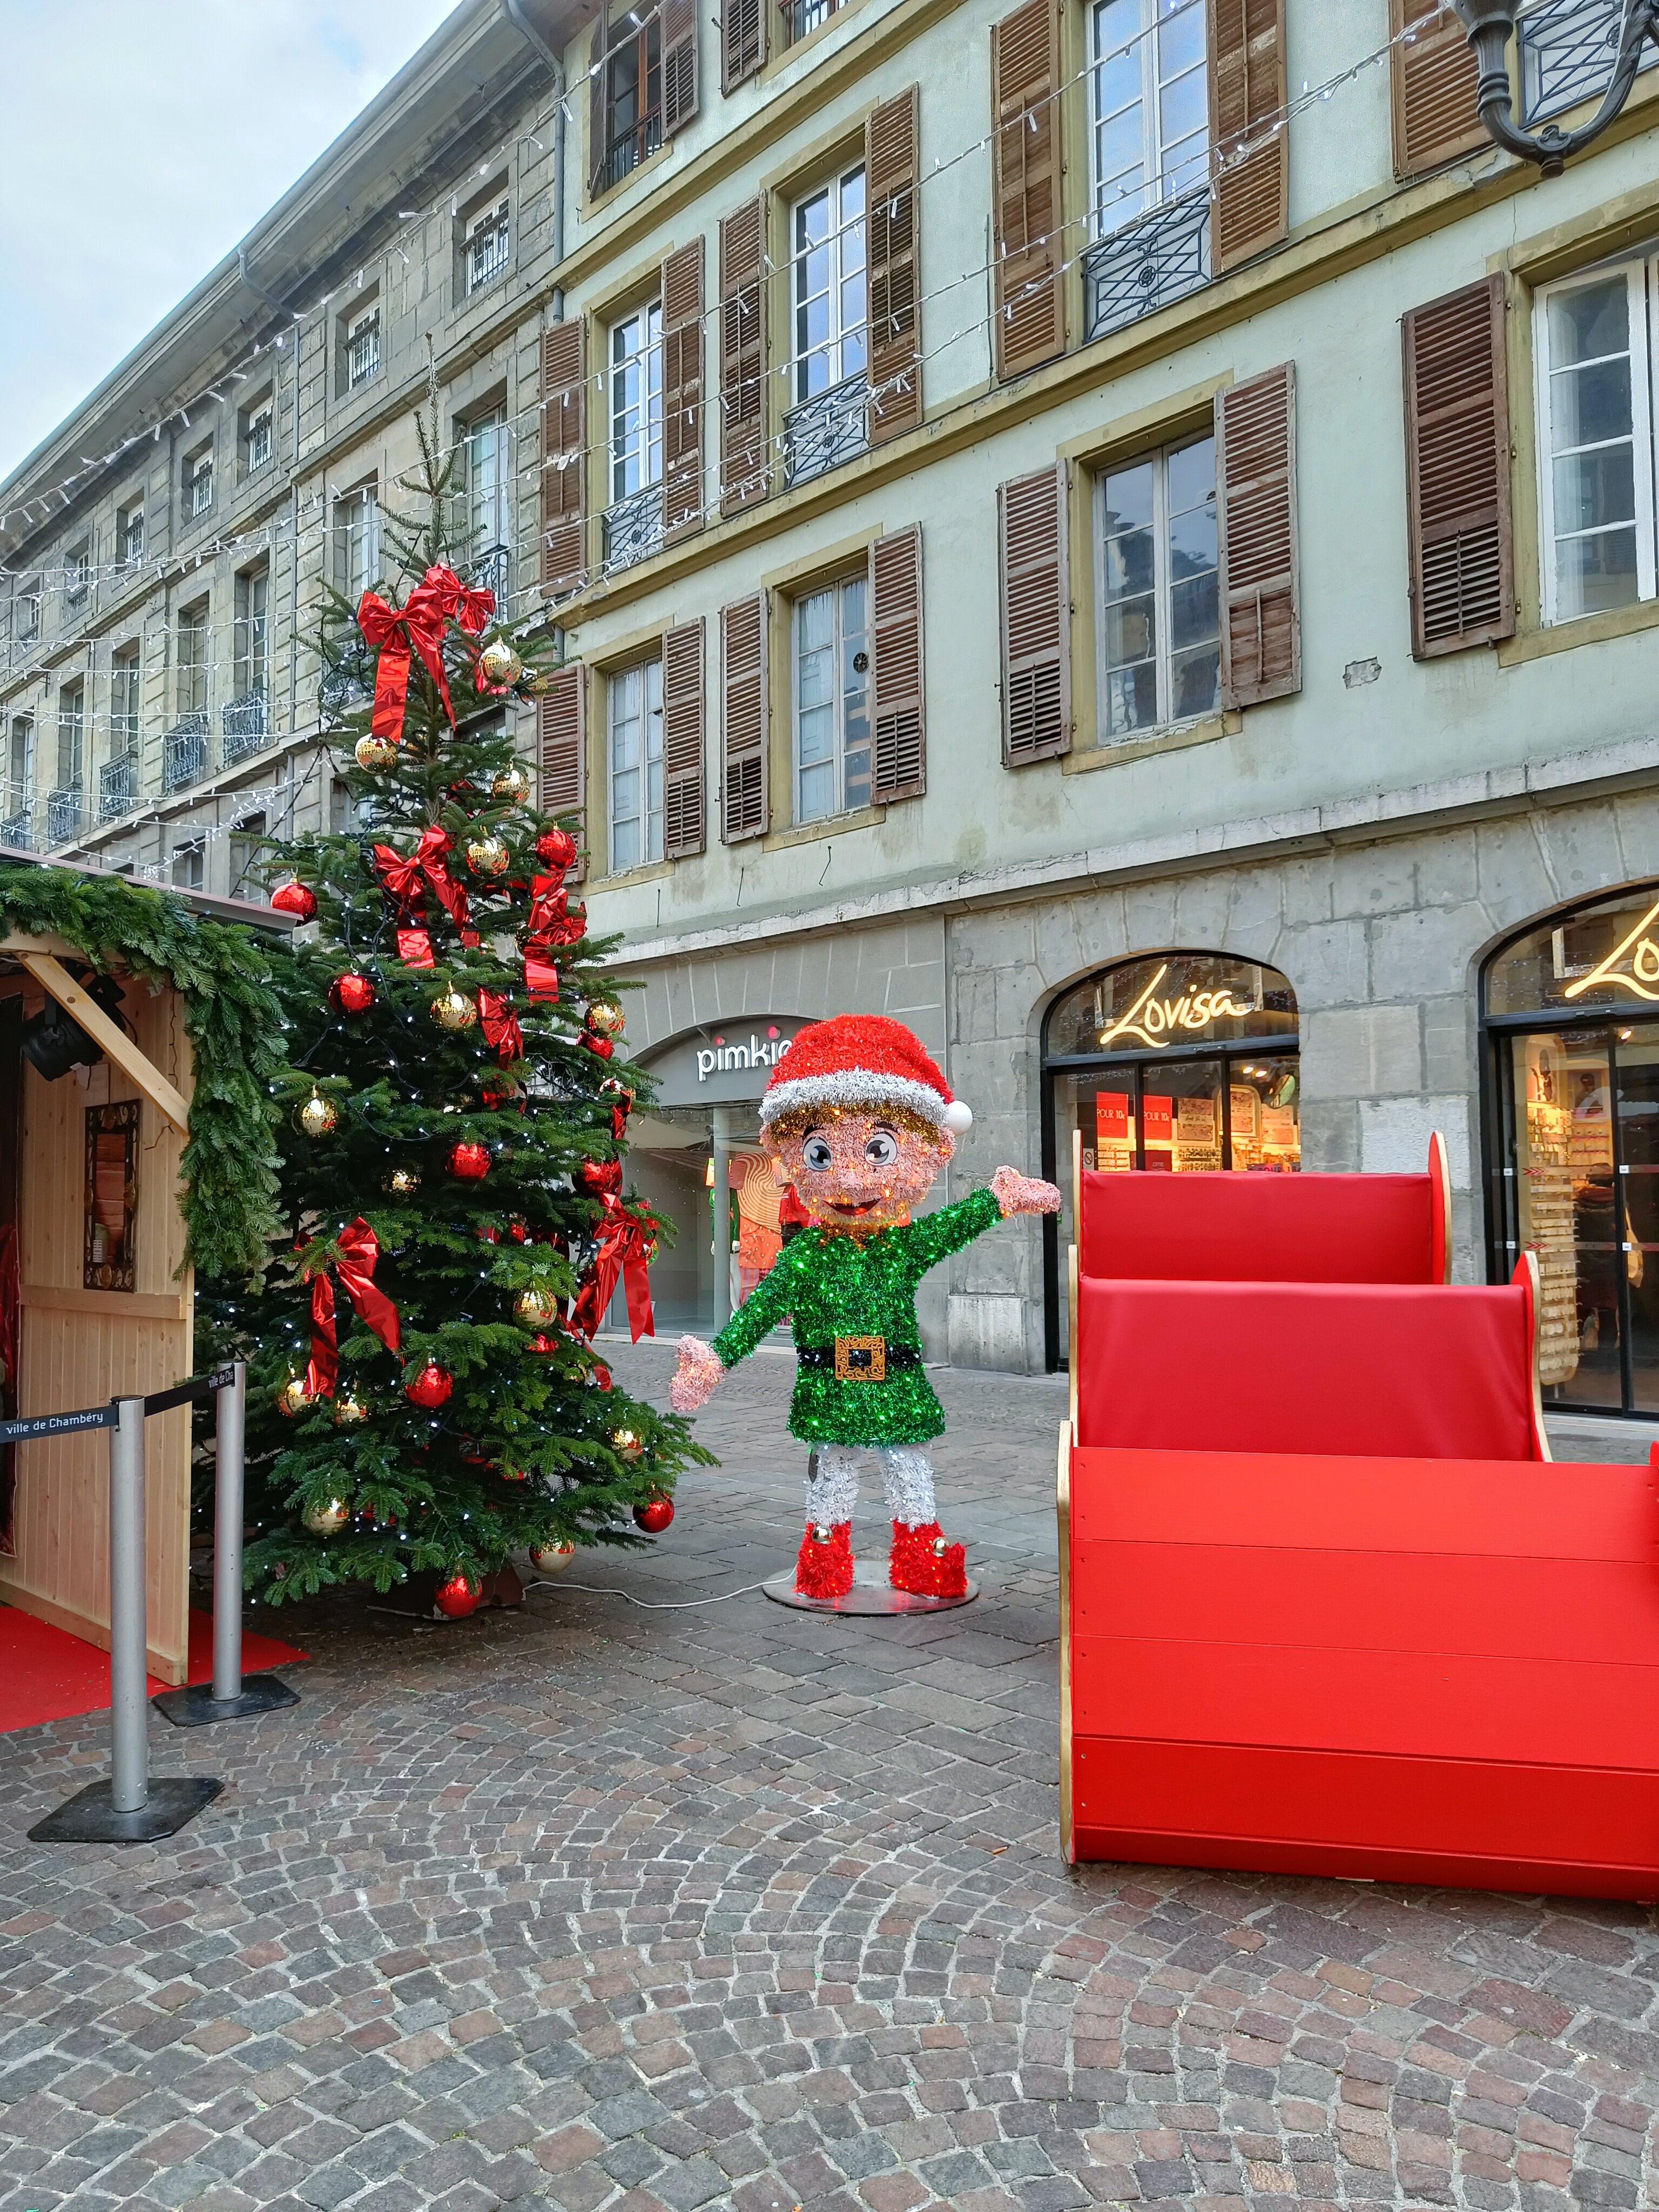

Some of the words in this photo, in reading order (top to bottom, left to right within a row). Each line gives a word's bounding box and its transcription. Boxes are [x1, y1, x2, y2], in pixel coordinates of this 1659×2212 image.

[1100, 964, 1255, 1048] Lovisa
[1096, 1108, 1114, 1119] POUR
[6, 1423, 29, 1434] ville
[33, 1420, 46, 1431] de
[49, 1413, 103, 1428] Chambéry
